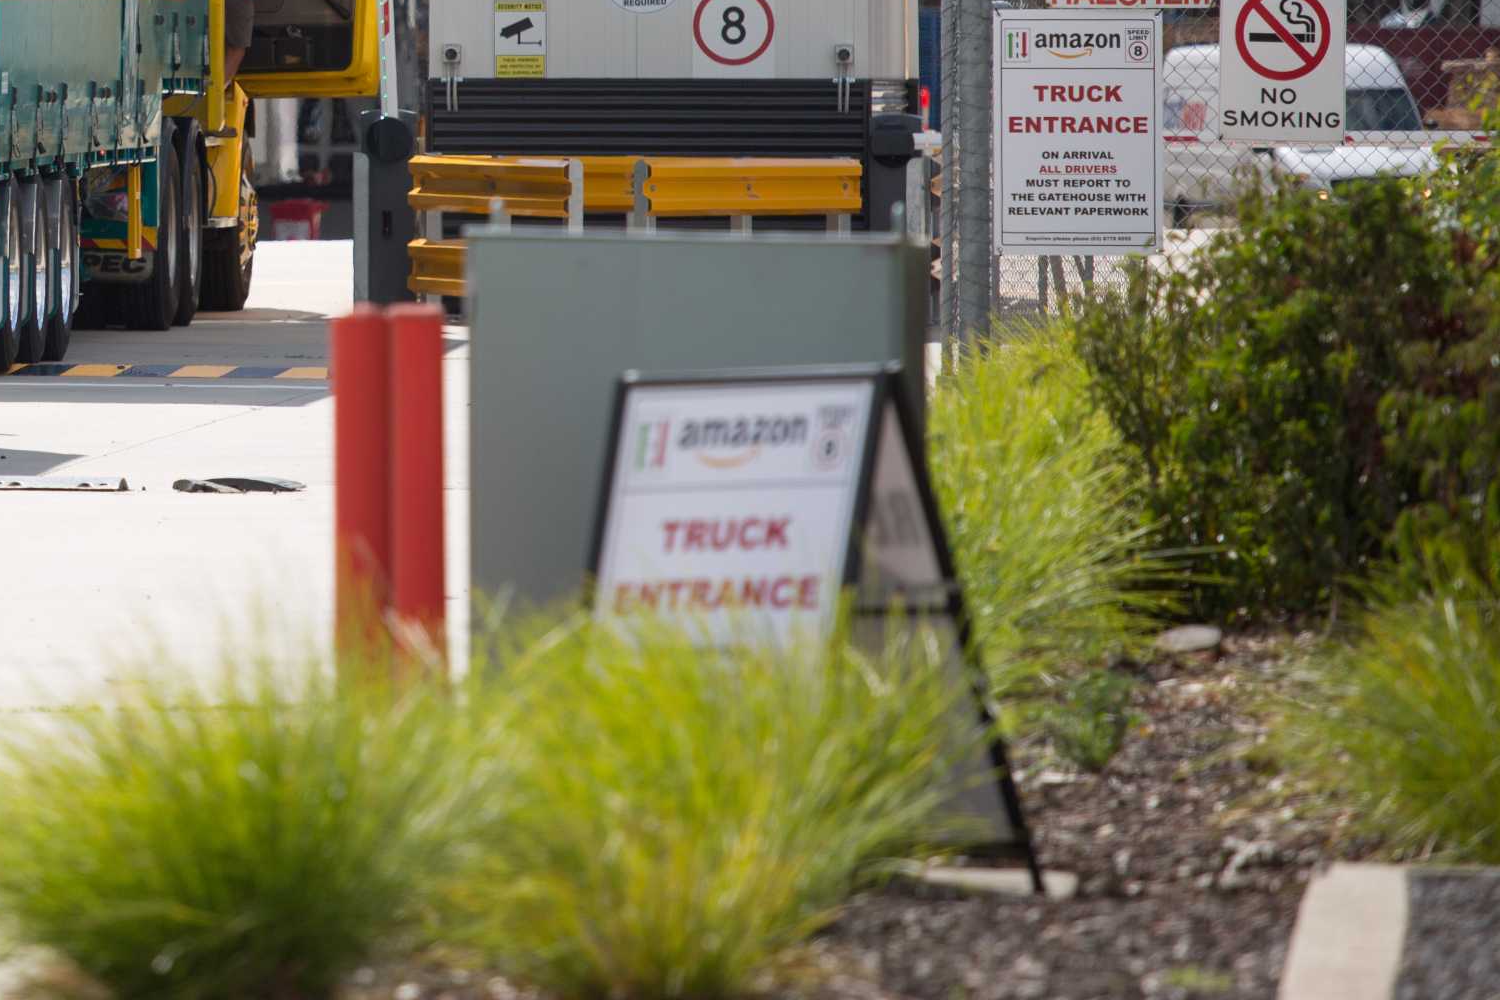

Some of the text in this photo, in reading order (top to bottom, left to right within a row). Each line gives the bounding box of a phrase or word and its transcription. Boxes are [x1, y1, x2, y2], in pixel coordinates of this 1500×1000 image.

[721, 6, 746, 45] 8
[1035, 32, 1121, 49] amazon
[1134, 45, 1143, 57] 8
[1033, 85, 1123, 103] TRUCK
[1261, 88, 1297, 104] NO
[1008, 116, 1148, 134] ENTRANCE
[1223, 110, 1340, 128] SMOKING
[1041, 151, 1114, 160] ON ARRIVAL
[1039, 165, 1117, 174] ALL DRIVERS
[1026, 179, 1131, 188] MUST REPORT TO
[1011, 193, 1146, 202] THE GATEHOUSE WITH
[1008, 207, 1149, 216] RELEVANT PAPERWORK
[679, 415, 808, 449] amazon
[662, 516, 790, 552] TRUCK
[614, 576, 820, 613] ENTRANCE
